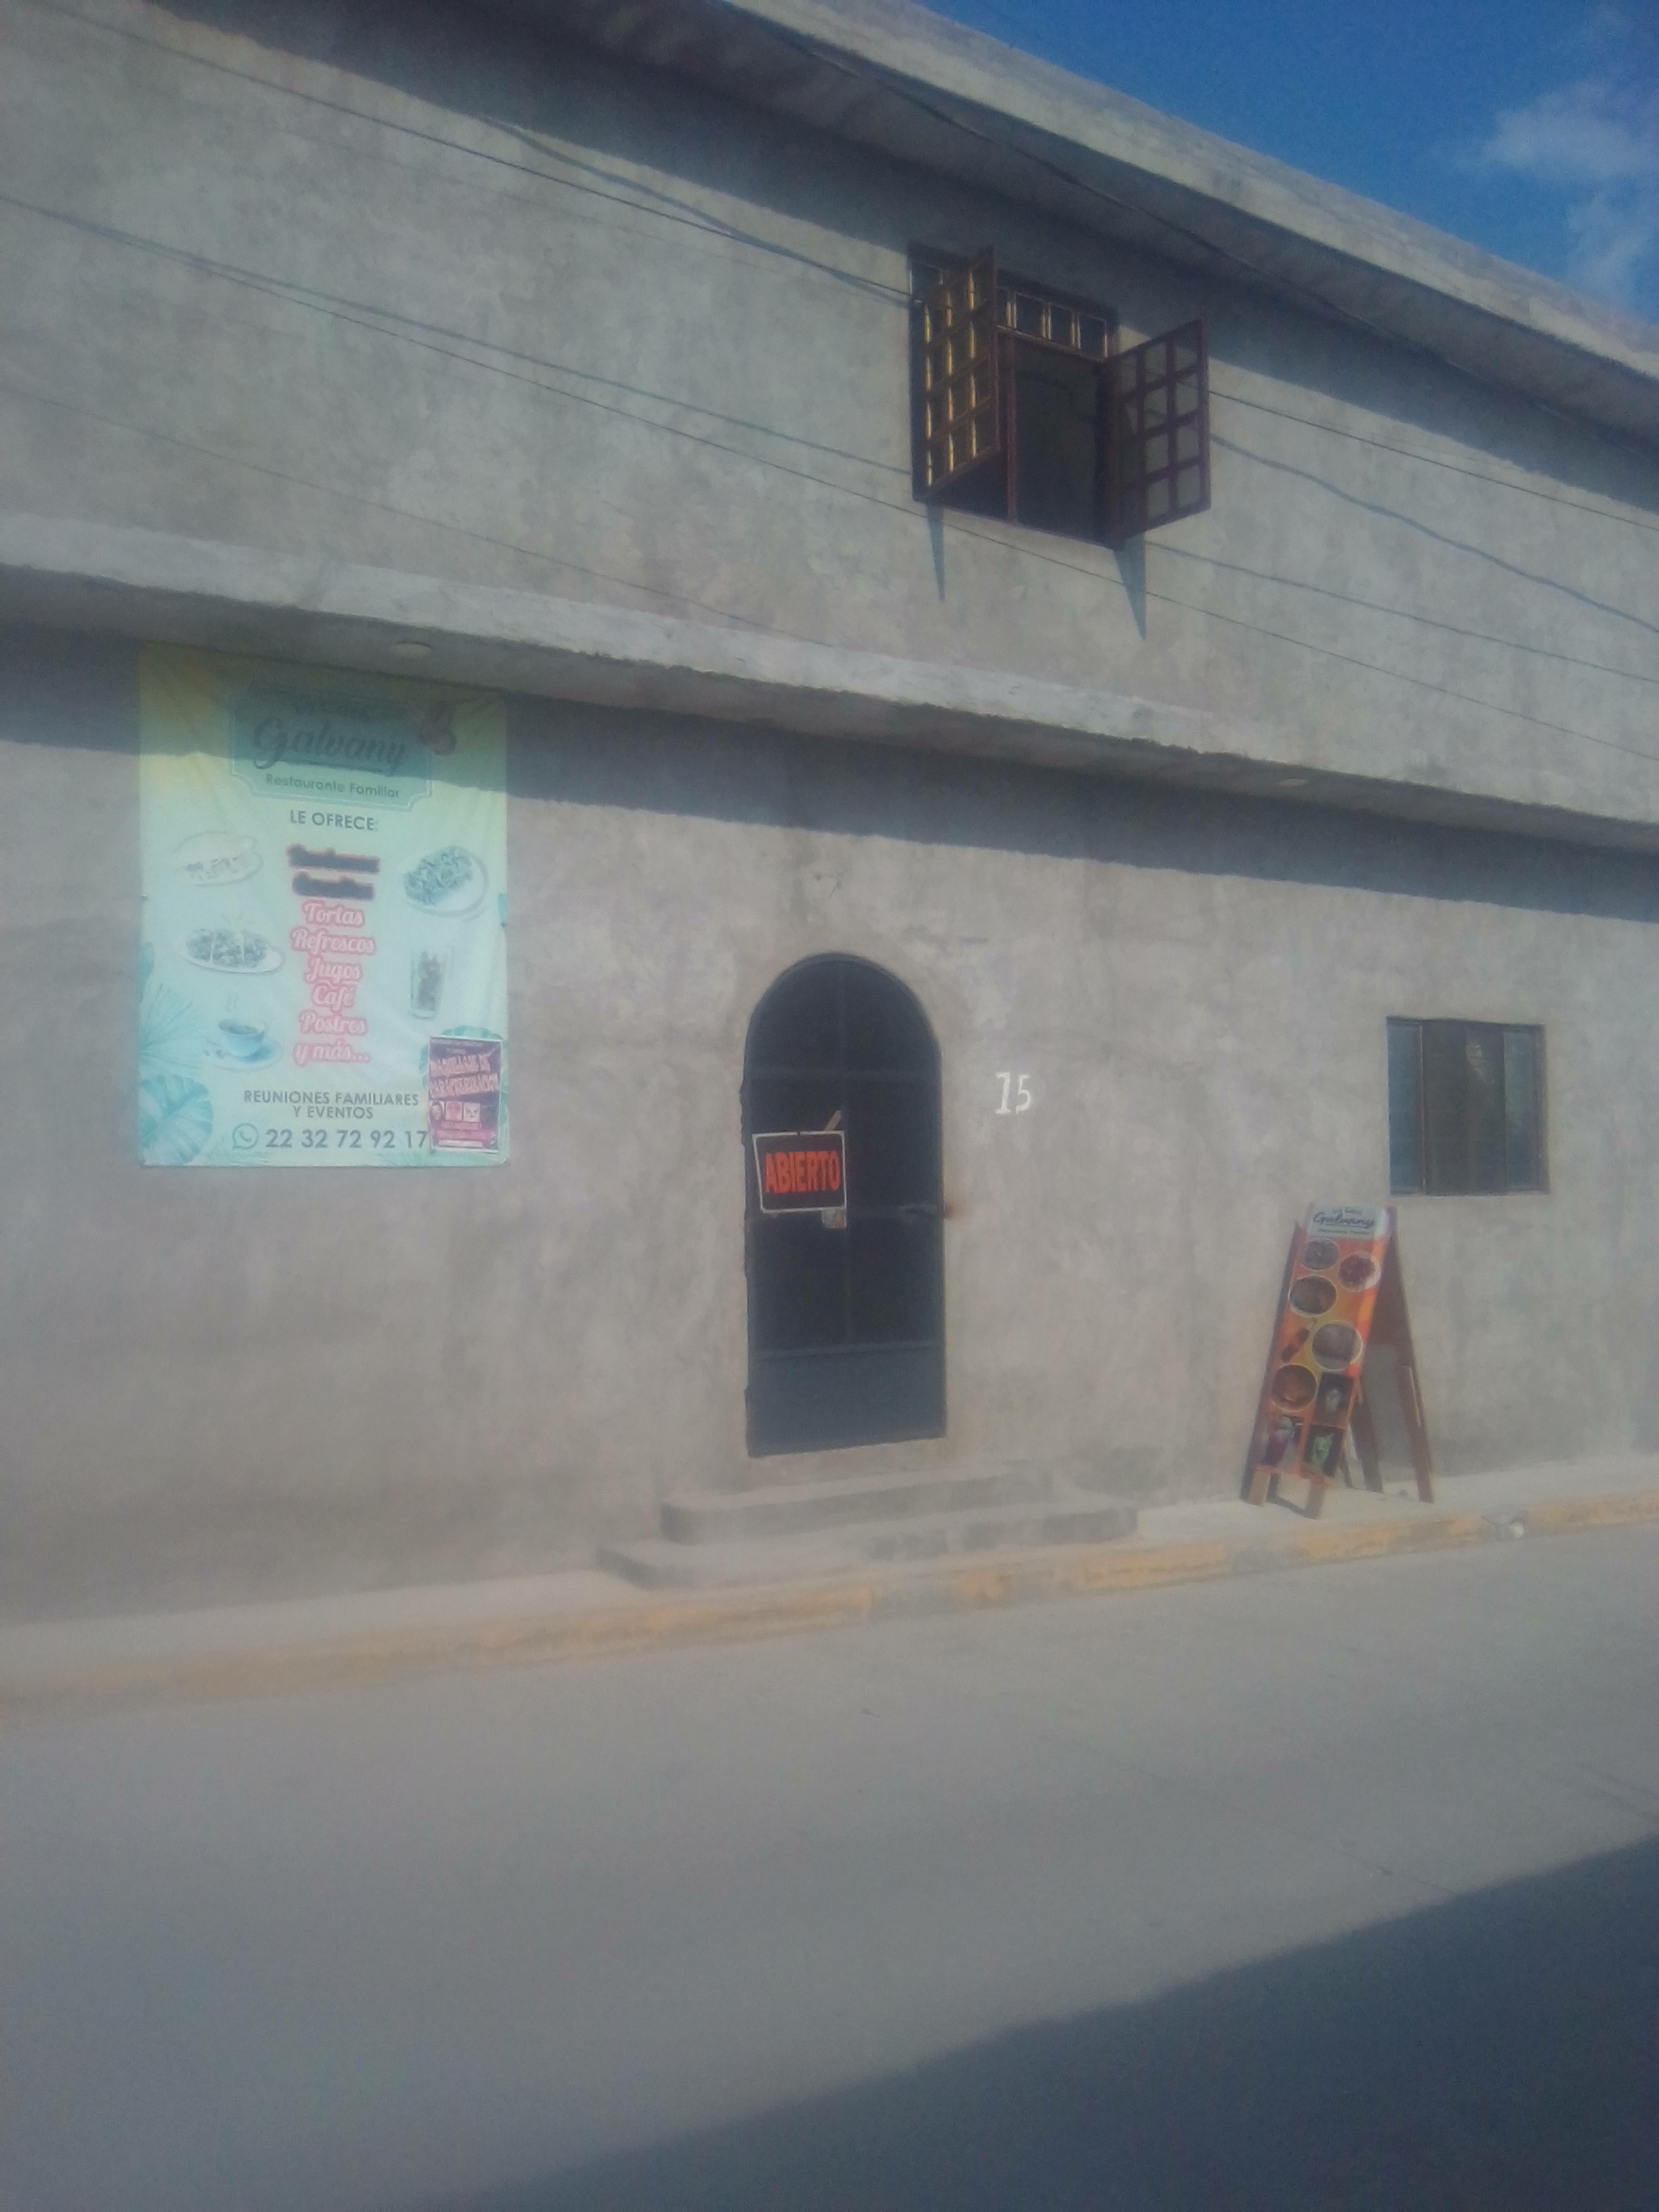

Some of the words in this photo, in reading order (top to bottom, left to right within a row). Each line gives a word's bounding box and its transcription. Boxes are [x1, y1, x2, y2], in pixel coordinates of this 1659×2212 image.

[266, 773, 346, 793] Restaurante
[350, 782, 401, 798] Familiar
[290, 810, 306, 824] LE
[312, 812, 379, 831] OFRECE:
[304, 903, 363, 923] Tortas
[293, 929, 375, 954] Refrescos
[304, 957, 361, 983] Jugos
[301, 1011, 366, 1033] Postres
[244, 1090, 330, 1105] REUNIONES
[335, 1092, 419, 1106] FAMILIARES
[996, 1071, 1032, 1115] 15
[293, 1105, 302, 1118] Y
[307, 1106, 373, 1120] EVENTOS
[265, 1128, 293, 1149] 22
[301, 1128, 328, 1149] 32
[336, 1130, 363, 1150] 72
[370, 1130, 396, 1150] 92
[405, 1130, 428, 1150] 17
[764, 1149, 841, 1193] ABIERTO
